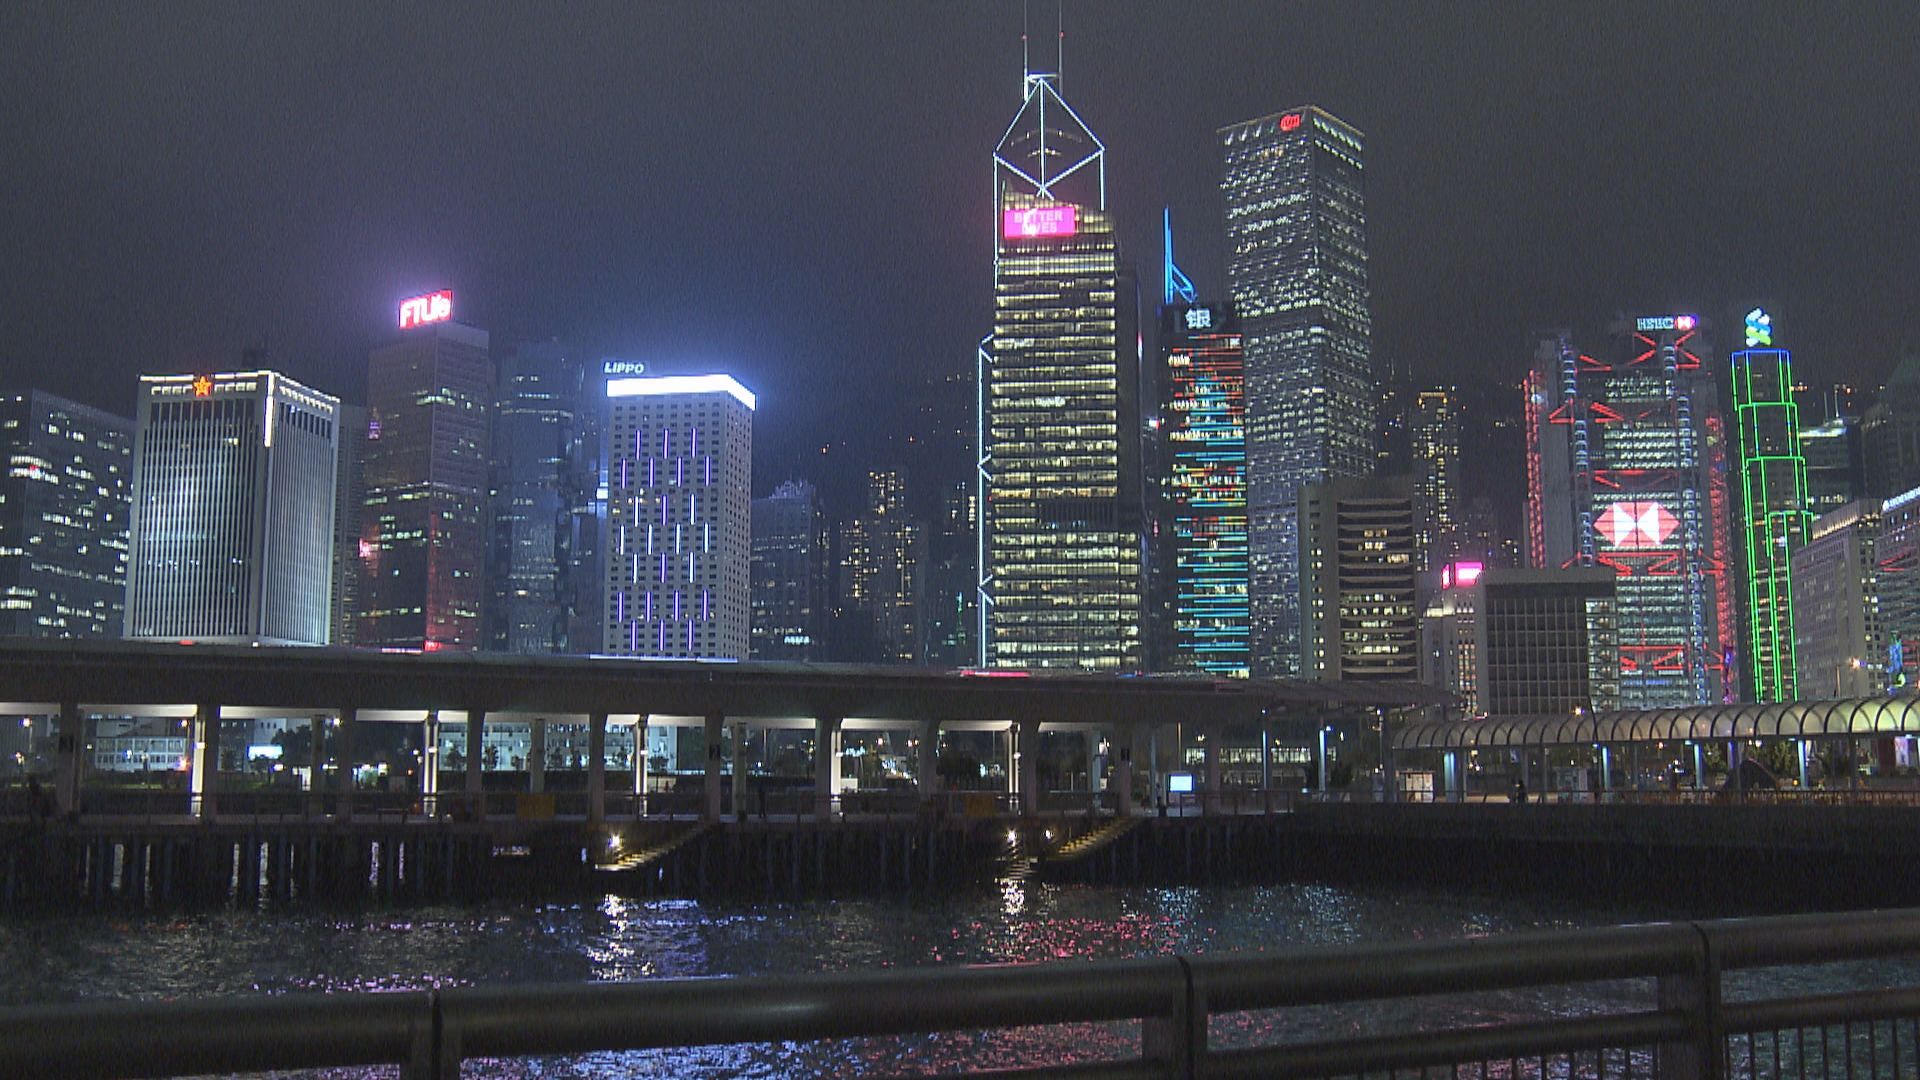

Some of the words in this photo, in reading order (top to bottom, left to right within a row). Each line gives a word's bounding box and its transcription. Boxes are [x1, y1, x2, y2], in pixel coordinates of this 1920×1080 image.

[1014, 209, 1063, 223] BTTER
[1022, 222, 1057, 235] LVES
[1185, 308, 1211, 329] 銀
[604, 361, 645, 374] LIPPO
